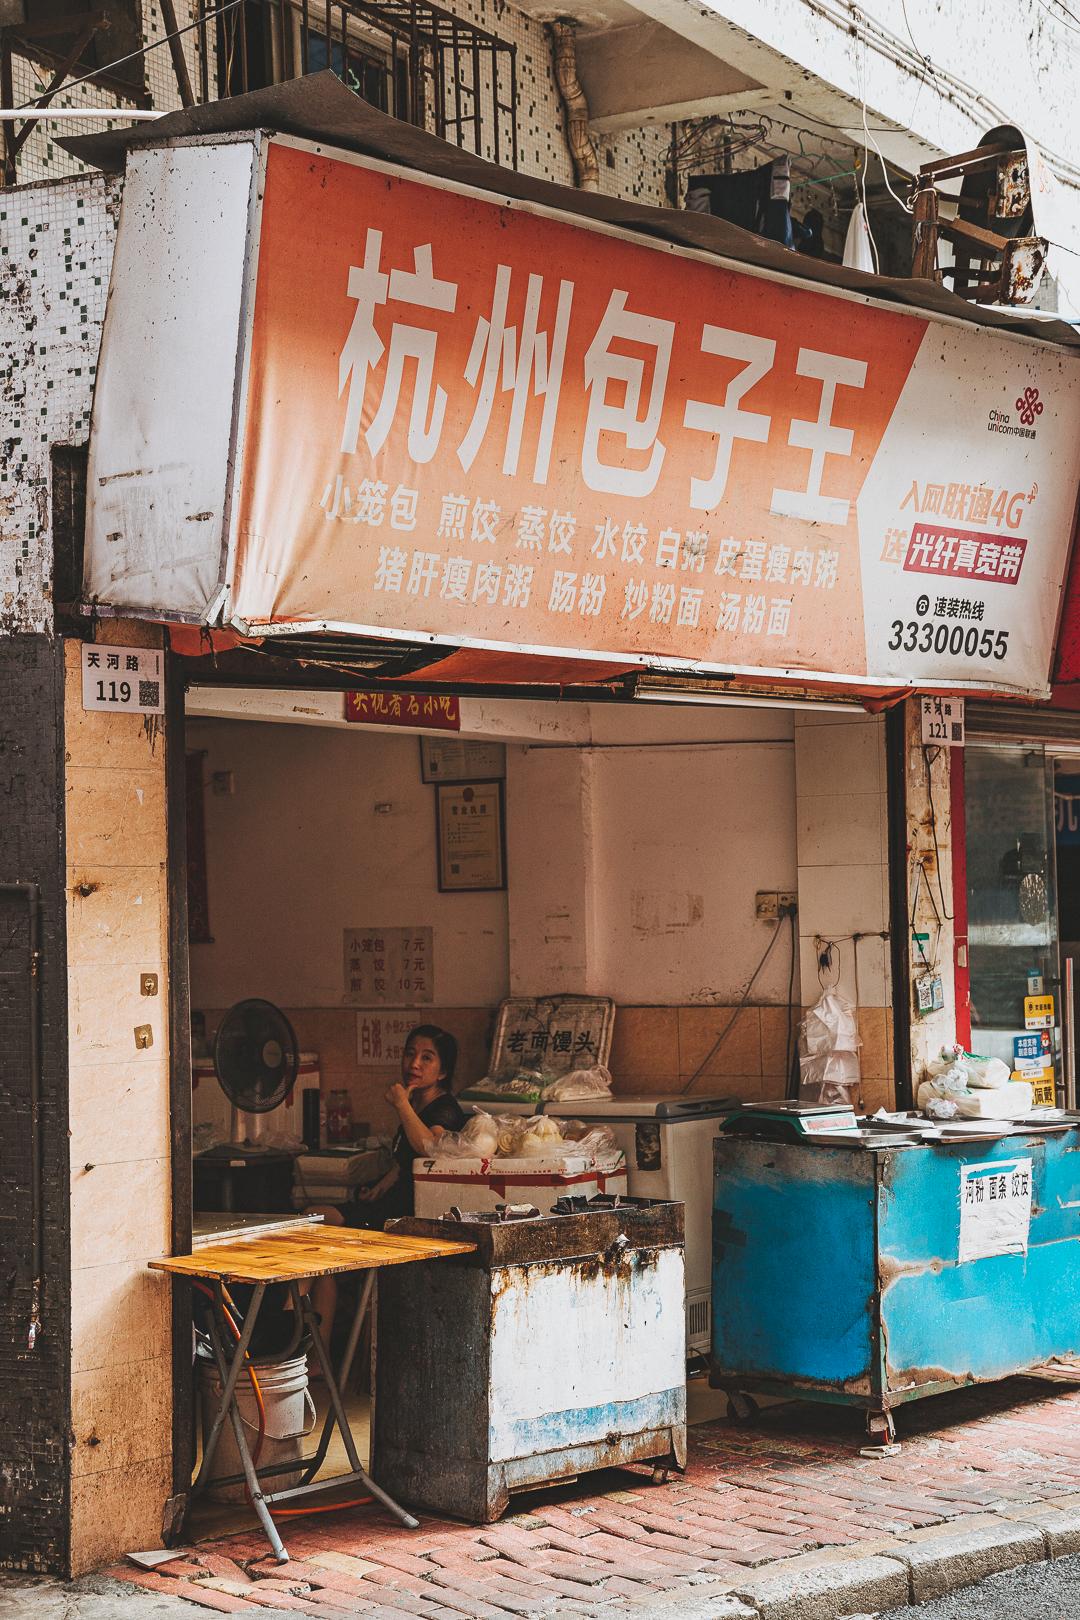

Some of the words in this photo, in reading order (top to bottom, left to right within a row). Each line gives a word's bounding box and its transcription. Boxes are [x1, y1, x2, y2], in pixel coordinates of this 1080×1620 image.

[338, 228, 868, 525] 杭州包子王
[989, 409, 1010, 423] China
[319, 474, 419, 531] 小笼包
[436, 492, 501, 543] 煎饺
[515, 505, 577, 555] 蒸饺
[591, 516, 649, 565] 水饺
[655, 527, 708, 573] 白粥
[714, 536, 840, 589] 皮蛋瘦肉粥
[373, 544, 534, 608] 猪肝瘦肉粥
[548, 569, 606, 617] 肠粉
[620, 578, 704, 627] 炒粉面
[716, 591, 793, 637] 汤粉面
[933, 596, 985, 621] 速装热线
[888, 620, 1010, 660] 33300055
[87, 652, 139, 672] 天河路
[96, 680, 132, 703] 119
[924, 702, 952, 716] 天河路
[929, 722, 948, 739] 121
[350, 937, 385, 953] 小笼包
[507, 1030, 595, 1053] 老面馒头
[965, 1178, 984, 1204] 河粉
[989, 1174, 1007, 1200] 面条
